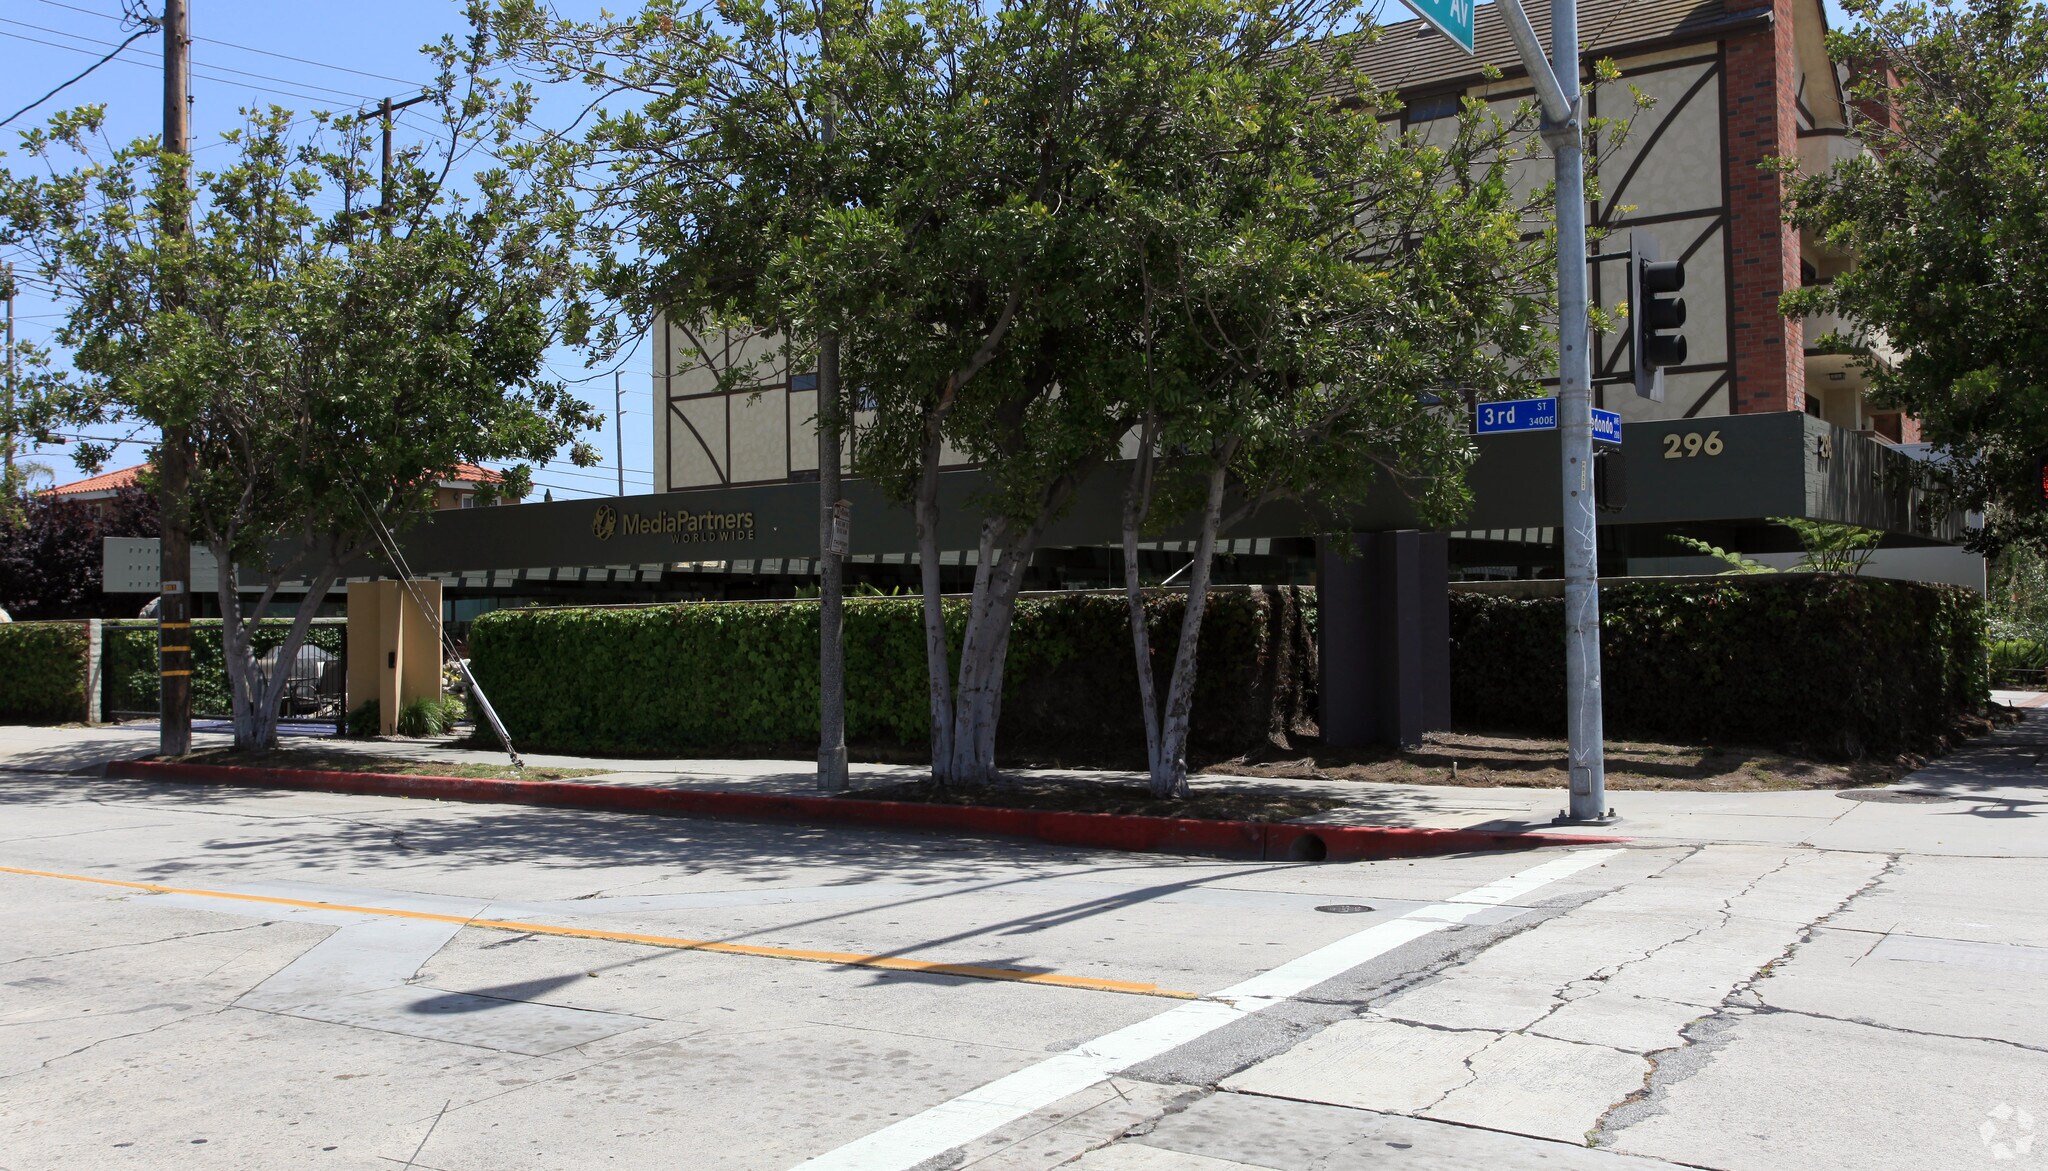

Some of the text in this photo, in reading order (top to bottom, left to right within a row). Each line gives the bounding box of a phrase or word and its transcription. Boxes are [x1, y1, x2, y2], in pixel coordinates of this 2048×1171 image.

[1537, 402, 1547, 411] ST
[1484, 405, 1516, 426] 3rd
[1528, 416, 1554, 426] 3400E
[1663, 430, 1724, 459] 296
[622, 510, 754, 536] MediaPartners
[671, 530, 755, 544] WORLDWIDE
